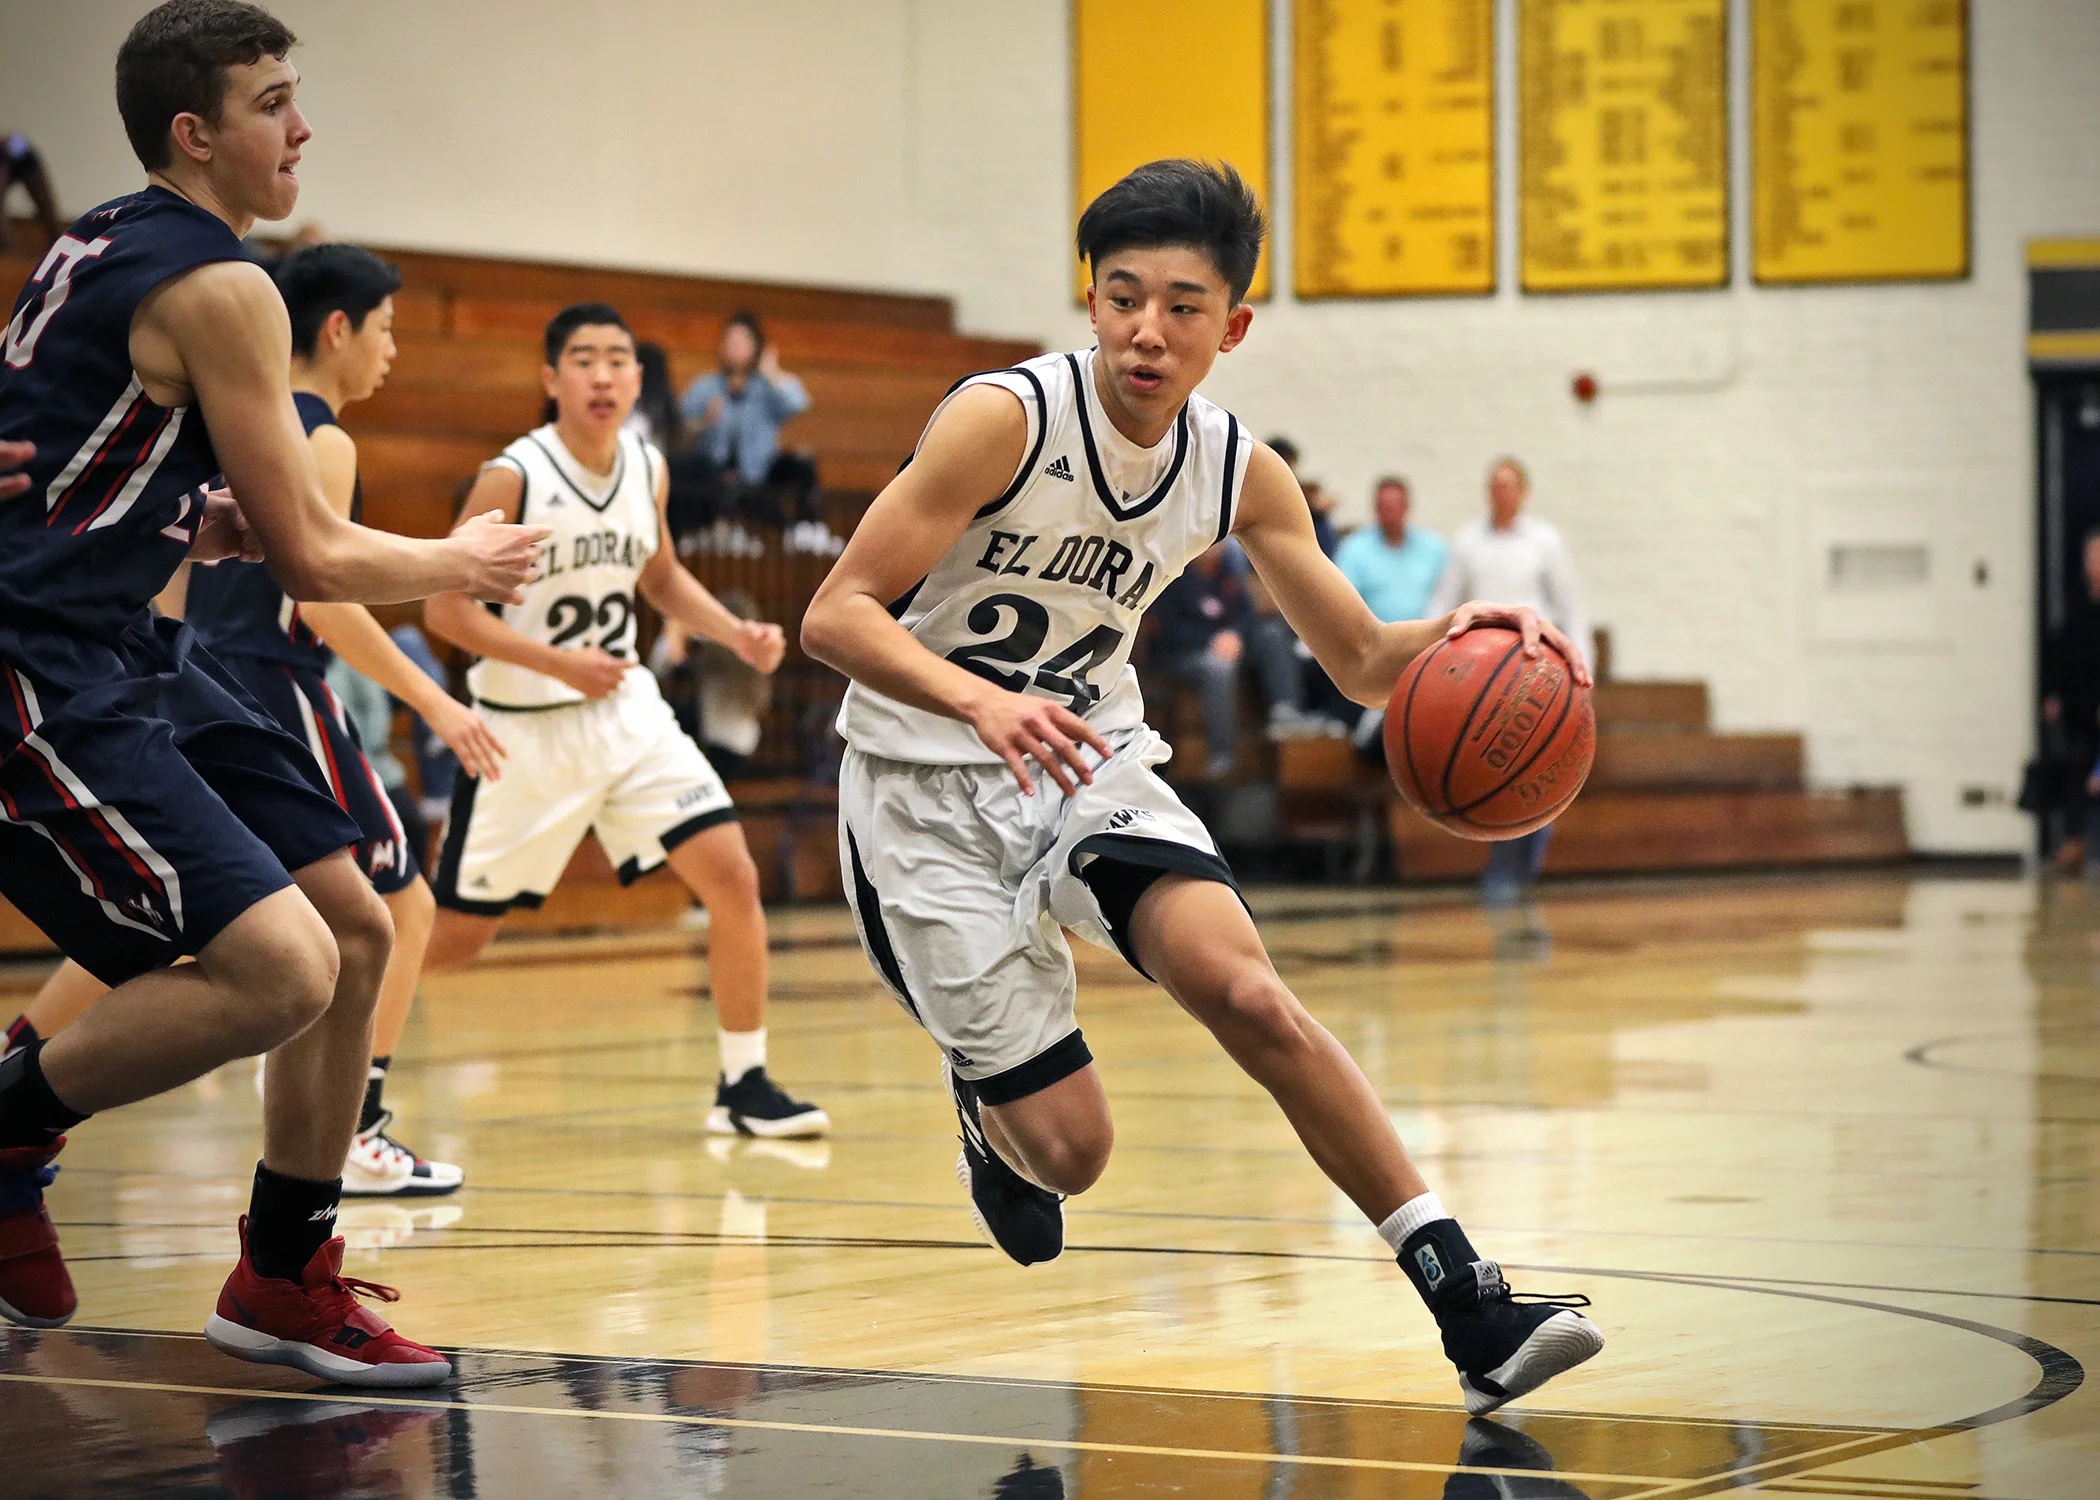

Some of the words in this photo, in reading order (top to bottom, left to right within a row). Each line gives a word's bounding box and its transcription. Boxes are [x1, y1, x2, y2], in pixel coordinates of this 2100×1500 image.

[1045, 466, 1075, 483] adidas
[976, 530, 1039, 577] EL
[547, 591, 634, 659] 22
[943, 592, 1124, 714] 24
[1105, 808, 1157, 831] AWKS
